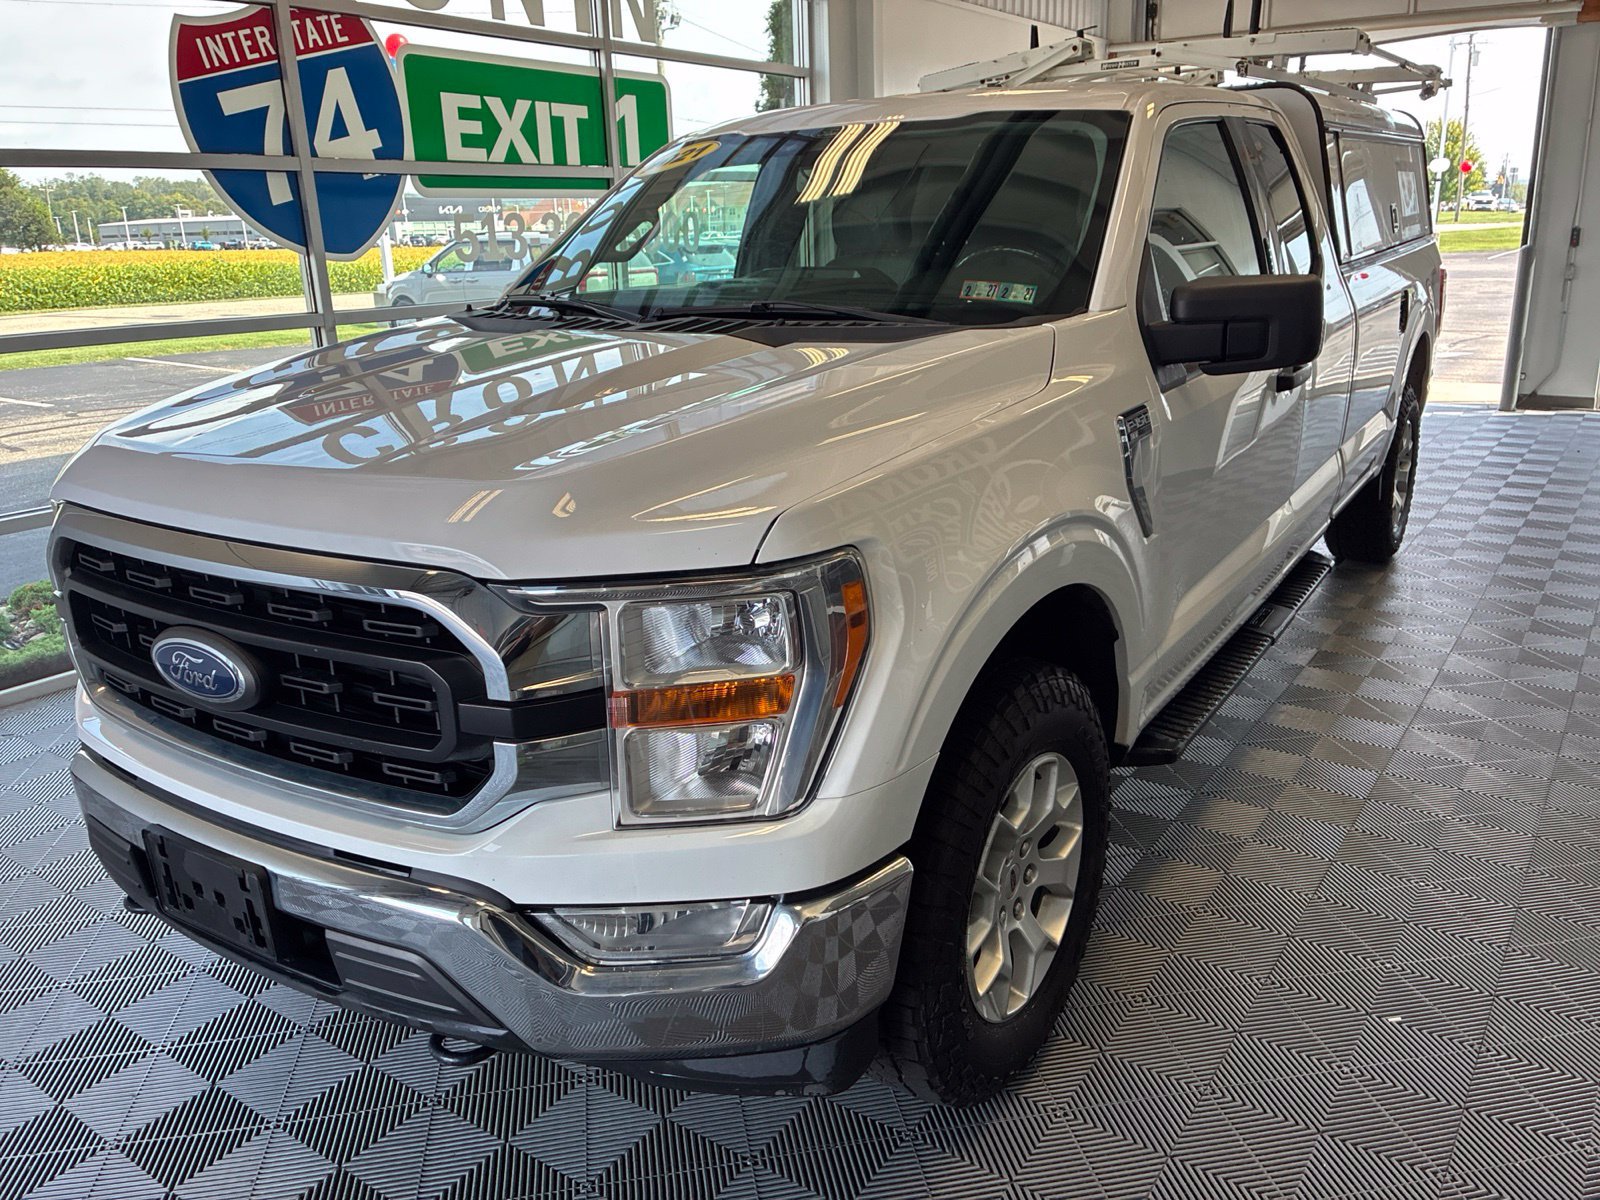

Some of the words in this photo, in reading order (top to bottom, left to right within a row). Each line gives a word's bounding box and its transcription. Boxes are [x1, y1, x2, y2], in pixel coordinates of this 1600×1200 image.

[195, 14, 349, 69] INTERTATE
[217, 67, 383, 206] 74
[440, 92, 589, 167] EXIT
[614, 94, 640, 167] 1
[170, 651, 218, 691] Ford
